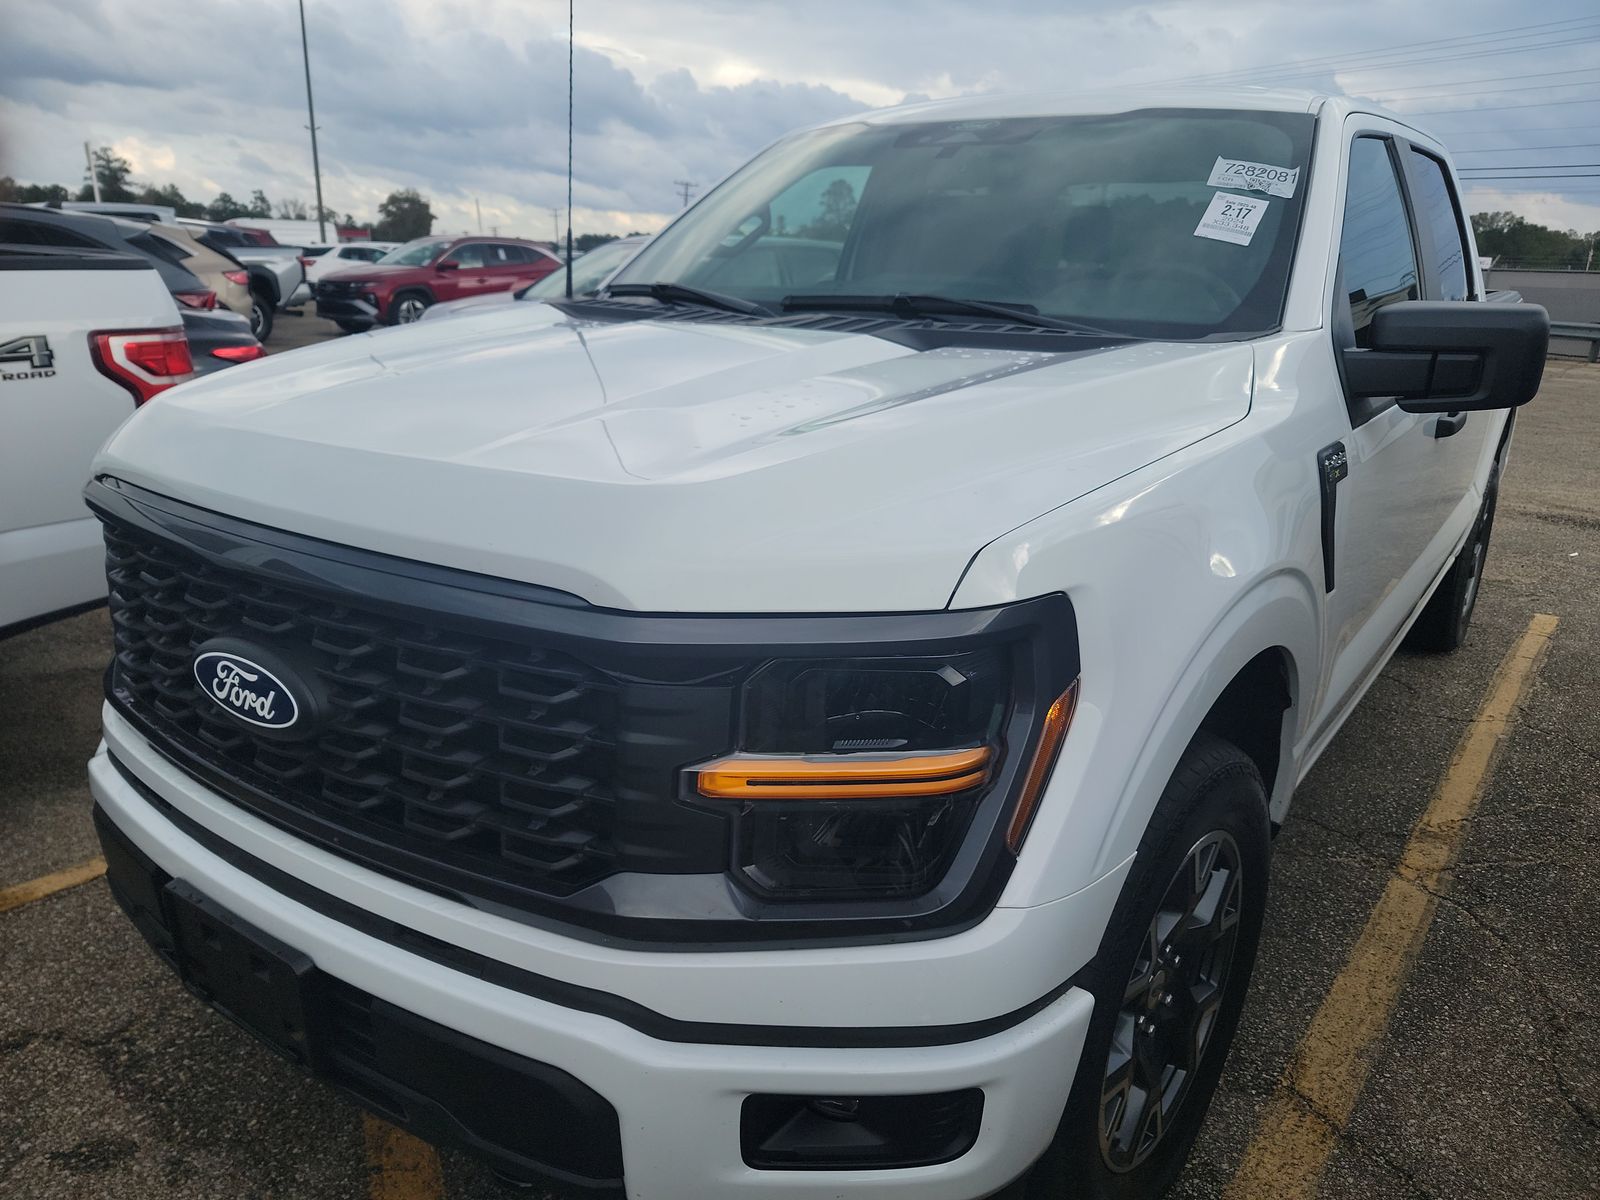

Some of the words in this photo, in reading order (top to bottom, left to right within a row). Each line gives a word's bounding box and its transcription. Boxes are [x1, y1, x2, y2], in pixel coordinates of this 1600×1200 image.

[1224, 162, 1298, 184] 7282081
[1221, 204, 1252, 219] 2:17
[2, 370, 56, 381] ROAD
[212, 660, 275, 720] Ford
